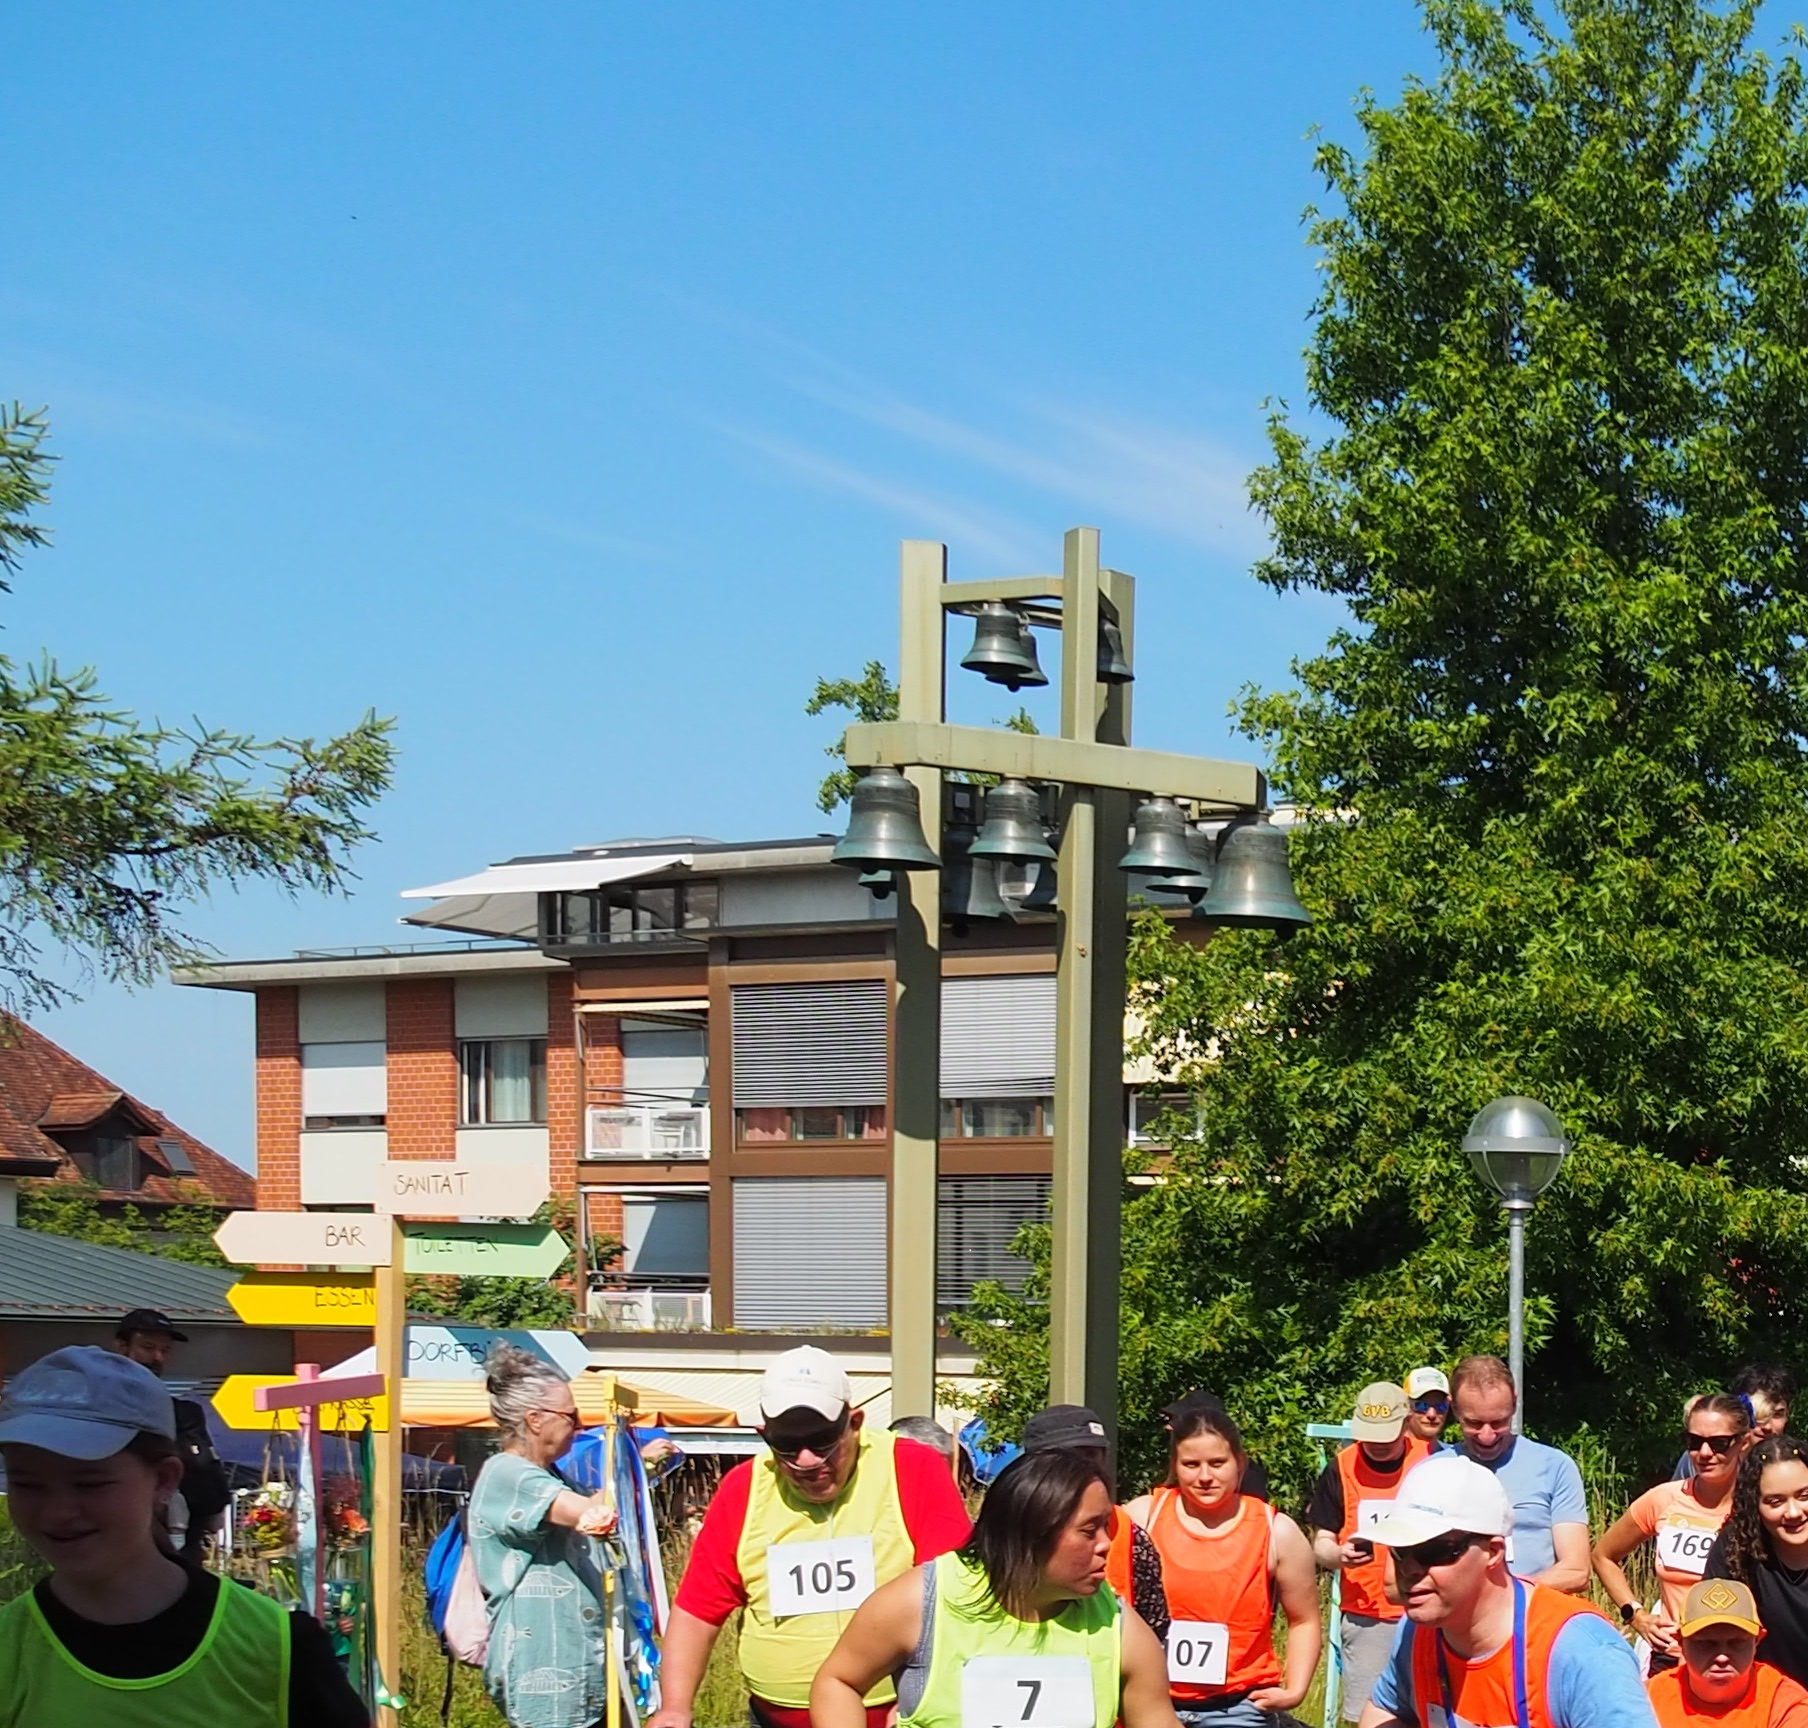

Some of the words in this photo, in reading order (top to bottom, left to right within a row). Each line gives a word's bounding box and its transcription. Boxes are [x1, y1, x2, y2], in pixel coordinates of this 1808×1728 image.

[325, 1225, 366, 1248] BAR
[314, 1287, 376, 1308] ESSEN
[407, 1340, 523, 1365] DORFB
[1670, 1531, 1714, 1559] 169
[788, 1558, 857, 1597] 105
[1016, 1680, 1042, 1721] 7
